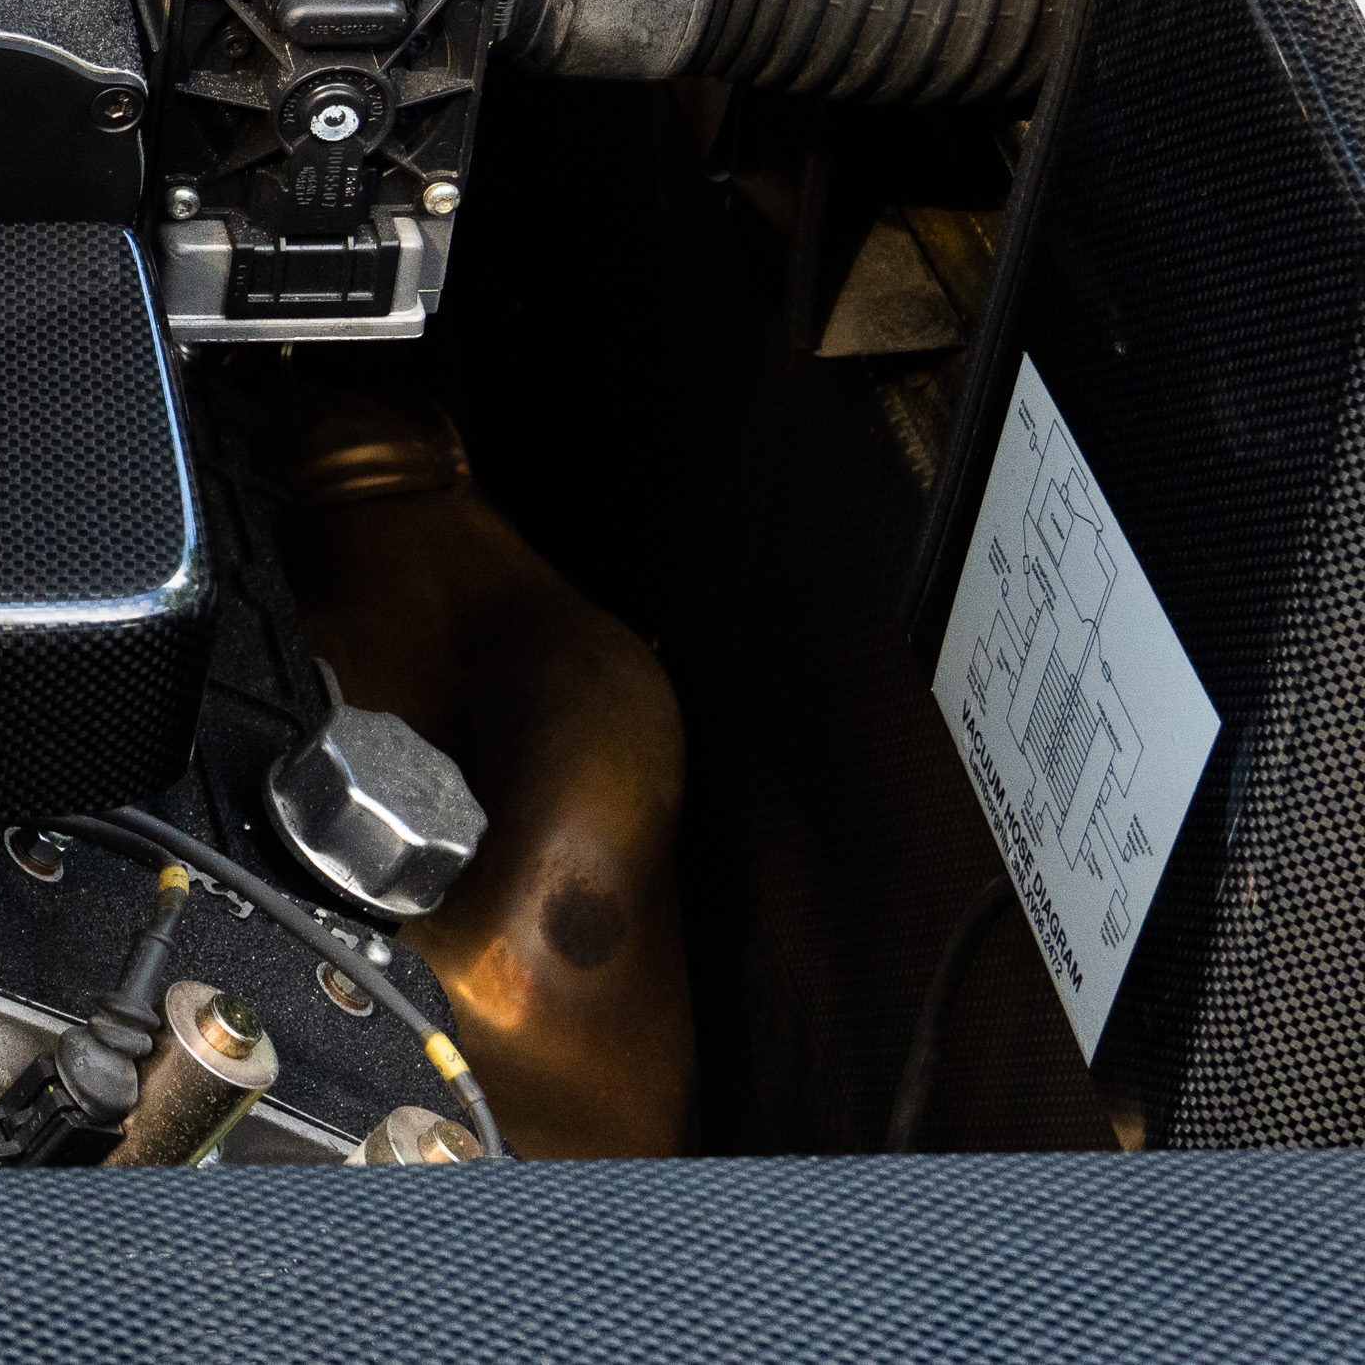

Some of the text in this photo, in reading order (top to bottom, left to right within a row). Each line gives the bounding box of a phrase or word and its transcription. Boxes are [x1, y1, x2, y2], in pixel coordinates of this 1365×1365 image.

[961, 699, 1005, 807] VACUUM
[1003, 801, 1034, 876] HOSE
[1031, 871, 1083, 992] DIAGRAM
[967, 749, 1012, 856] Lamborghini
